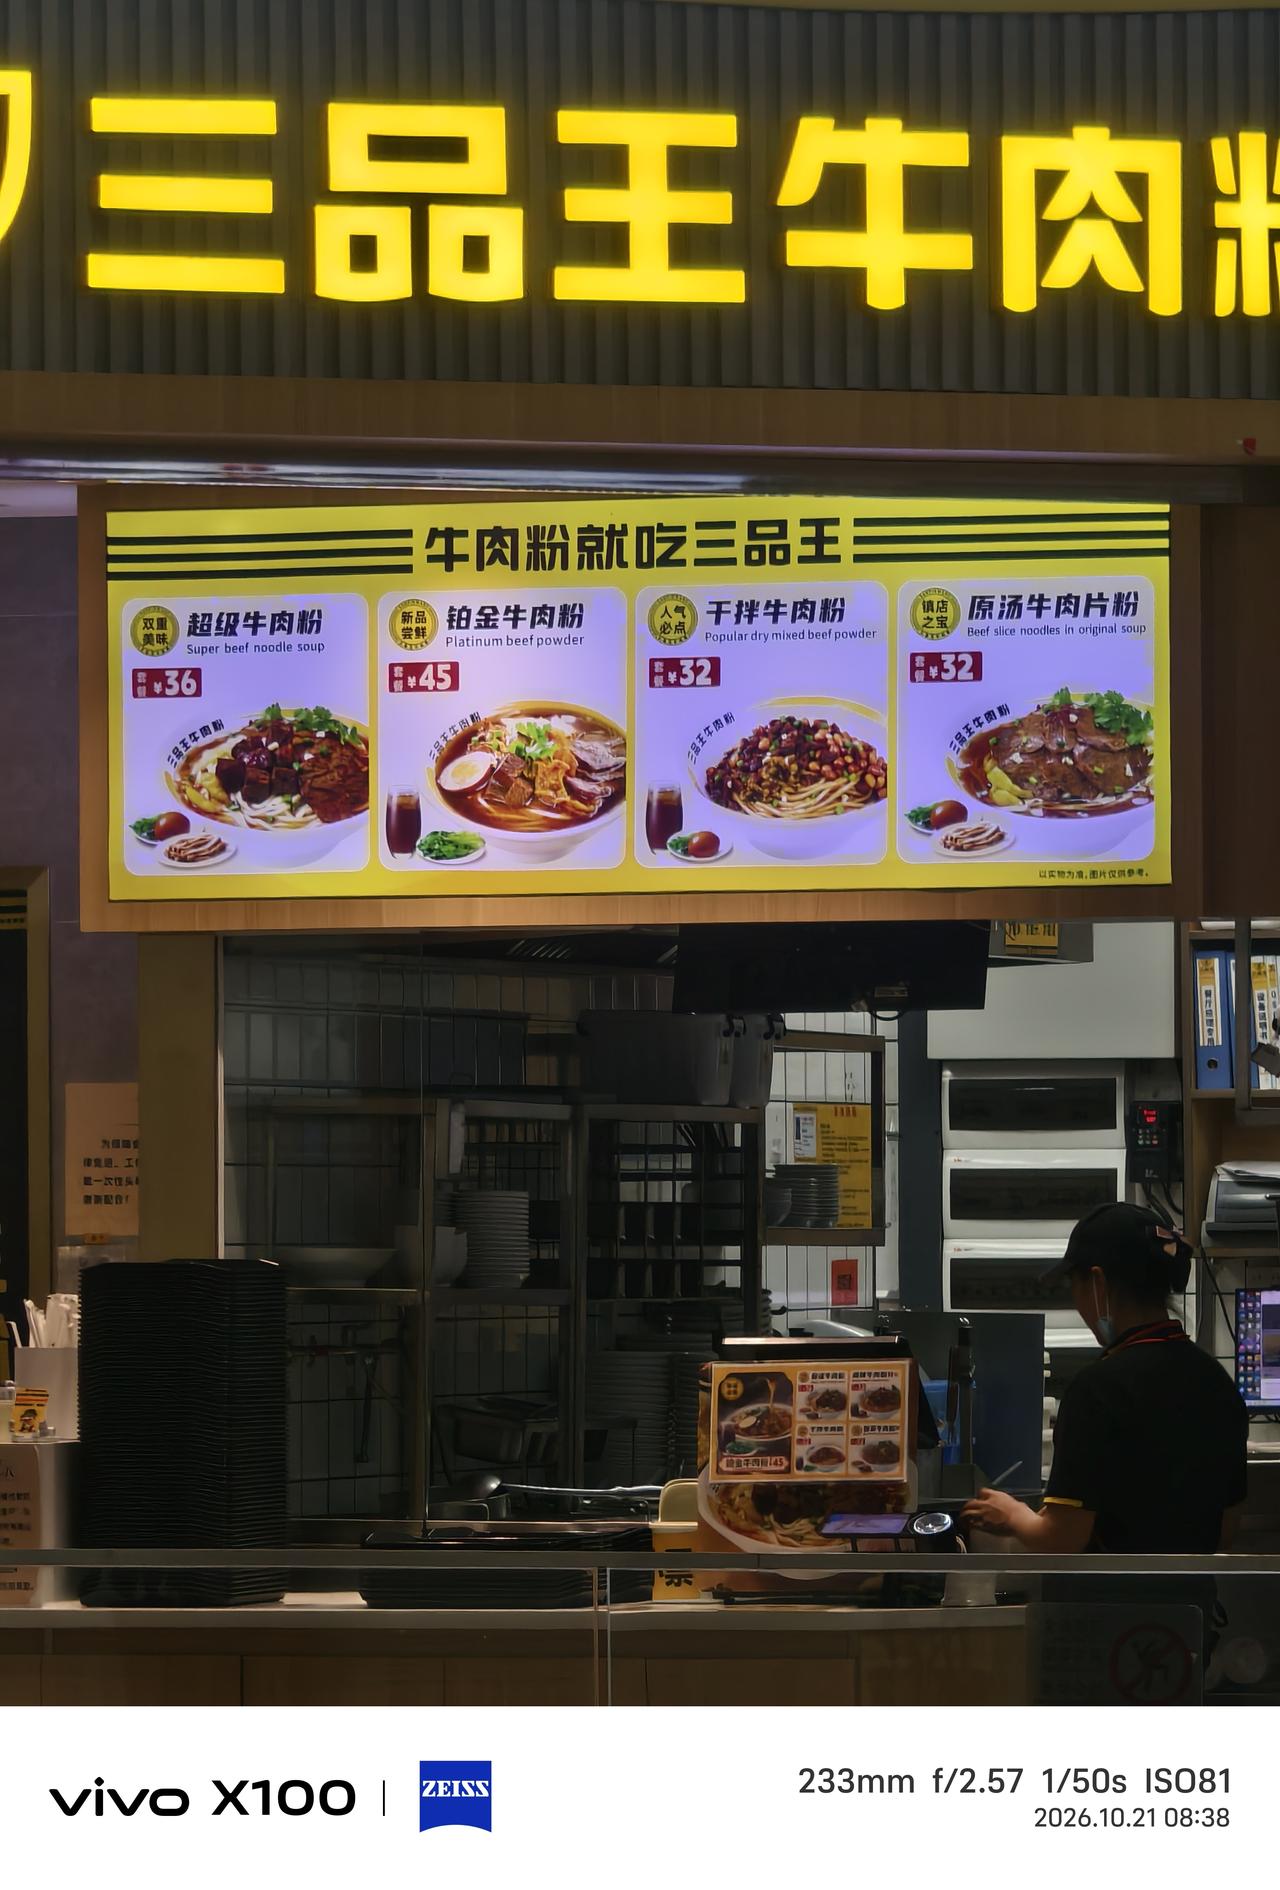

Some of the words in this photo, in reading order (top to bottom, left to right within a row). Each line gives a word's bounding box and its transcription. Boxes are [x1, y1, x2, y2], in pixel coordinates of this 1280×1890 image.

[424, 517, 842, 572] 牛肉粉就吃三品王
[660, 605, 686, 619] 人气
[706, 597, 846, 626] 干拌牛肉粉
[967, 591, 1139, 620] 原汤牛肉片粉
[142, 617, 168, 631] 双重
[187, 609, 323, 637] 超级牛肉粉
[401, 610, 427, 624] 新品
[446, 603, 584, 630] 铂金牛肉粉
[922, 615, 949, 629] 之宝
[401, 627, 427, 640] 尝鲜
[660, 621, 687, 635] 必点
[705, 631, 748, 643] Popular
[751, 630, 769, 643] dry
[772, 629, 805, 641] mixed
[808, 629, 833, 640] beef
[835, 628, 877, 641] powder
[967, 626, 989, 637] Beef
[993, 625, 1016, 636] slice
[1020, 624, 1061, 636] noodles
[1064, 624, 1074, 635] in
[1078, 623, 1117, 637] original
[1121, 624, 1147, 636] soup
[142, 633, 168, 646] 美味
[446, 636, 503, 648] Platinum
[506, 635, 534, 646] beef
[537, 634, 585, 648] powder
[187, 644, 220, 656] Super
[224, 642, 249, 654] beef
[254, 641, 293, 653] noodle
[297, 642, 325, 653] soup
[668, 658, 712, 686] ¥32
[929, 653, 974, 681] ¥32
[153, 670, 197, 696] ¥36
[407, 663, 452, 691] ¥45
